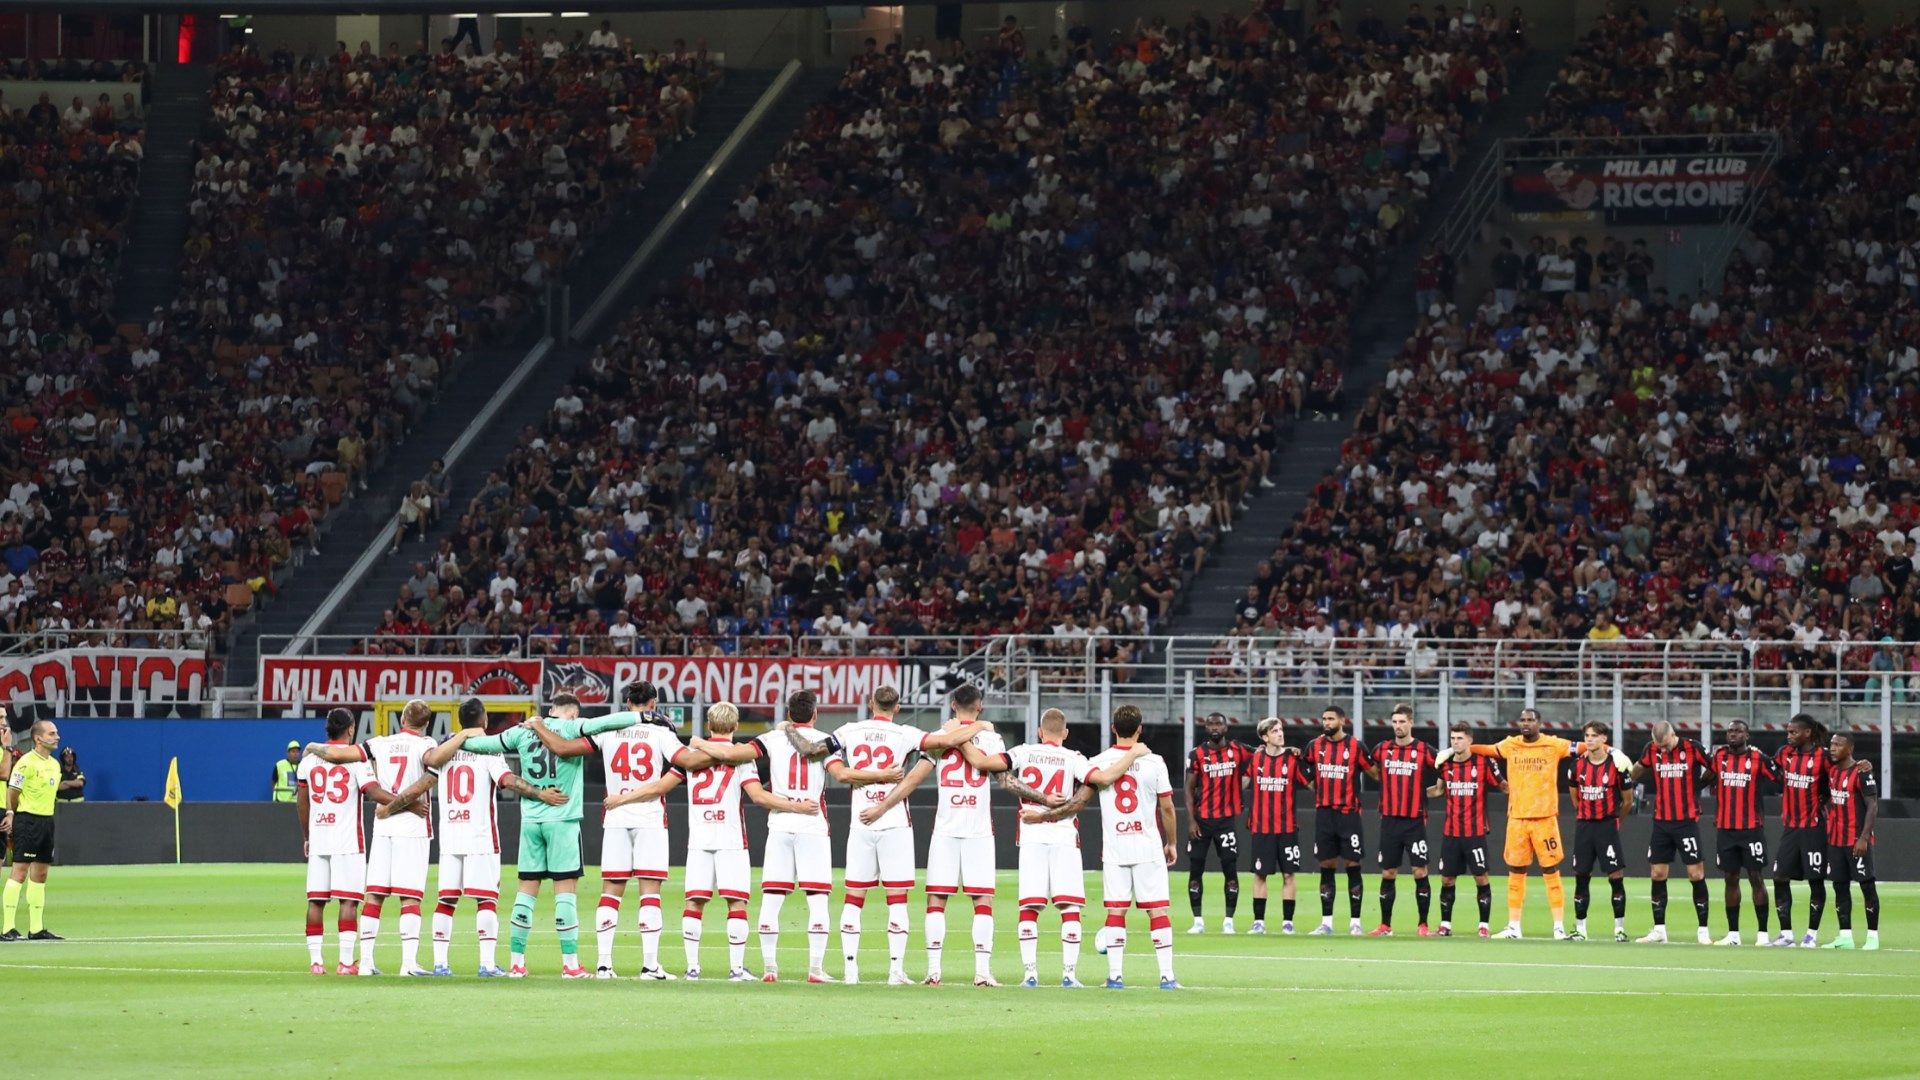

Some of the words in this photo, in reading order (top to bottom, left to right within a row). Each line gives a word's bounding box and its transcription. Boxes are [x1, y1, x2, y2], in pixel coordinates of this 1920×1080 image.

[1603, 159, 1676, 176] MILAN
[1687, 158, 1747, 175] CLUB
[1603, 181, 1744, 207] RICCIONE
[272, 668, 367, 702] MILAN
[379, 669, 454, 698] CLUB
[528, 741, 557, 779] 31
[611, 742, 653, 781] 43
[1203, 761, 1236, 772] Emirates
[1385, 760, 1418, 770] Emirates
[1656, 762, 1688, 771] Emirates
[389, 756, 408, 794] 7
[788, 752, 809, 790] 11
[1318, 763, 1349, 773] Emirates
[1720, 771, 1751, 780] Emirates
[1257, 776, 1289, 785] Emirates
[1785, 771, 1815, 782] Emirates
[310, 766, 350, 804] 93
[447, 765, 474, 804] 10
[692, 764, 735, 805] 27
[1447, 781, 1478, 789] Emirates
[951, 795, 977, 806] CAB
[1114, 774, 1138, 814] 8
[1116, 821, 1142, 832] CAB
[1220, 832, 1236, 847] 23
[1351, 834, 1359, 847] 8
[1543, 837, 1557, 851] 16
[1682, 837, 1698, 852] 31
[1285, 845, 1300, 860] 56
[1412, 840, 1427, 855] 46
[1472, 847, 1485, 863] 11
[1606, 845, 1616, 858] 4
[1749, 841, 1763, 856] 19
[1808, 852, 1821, 866] 10
